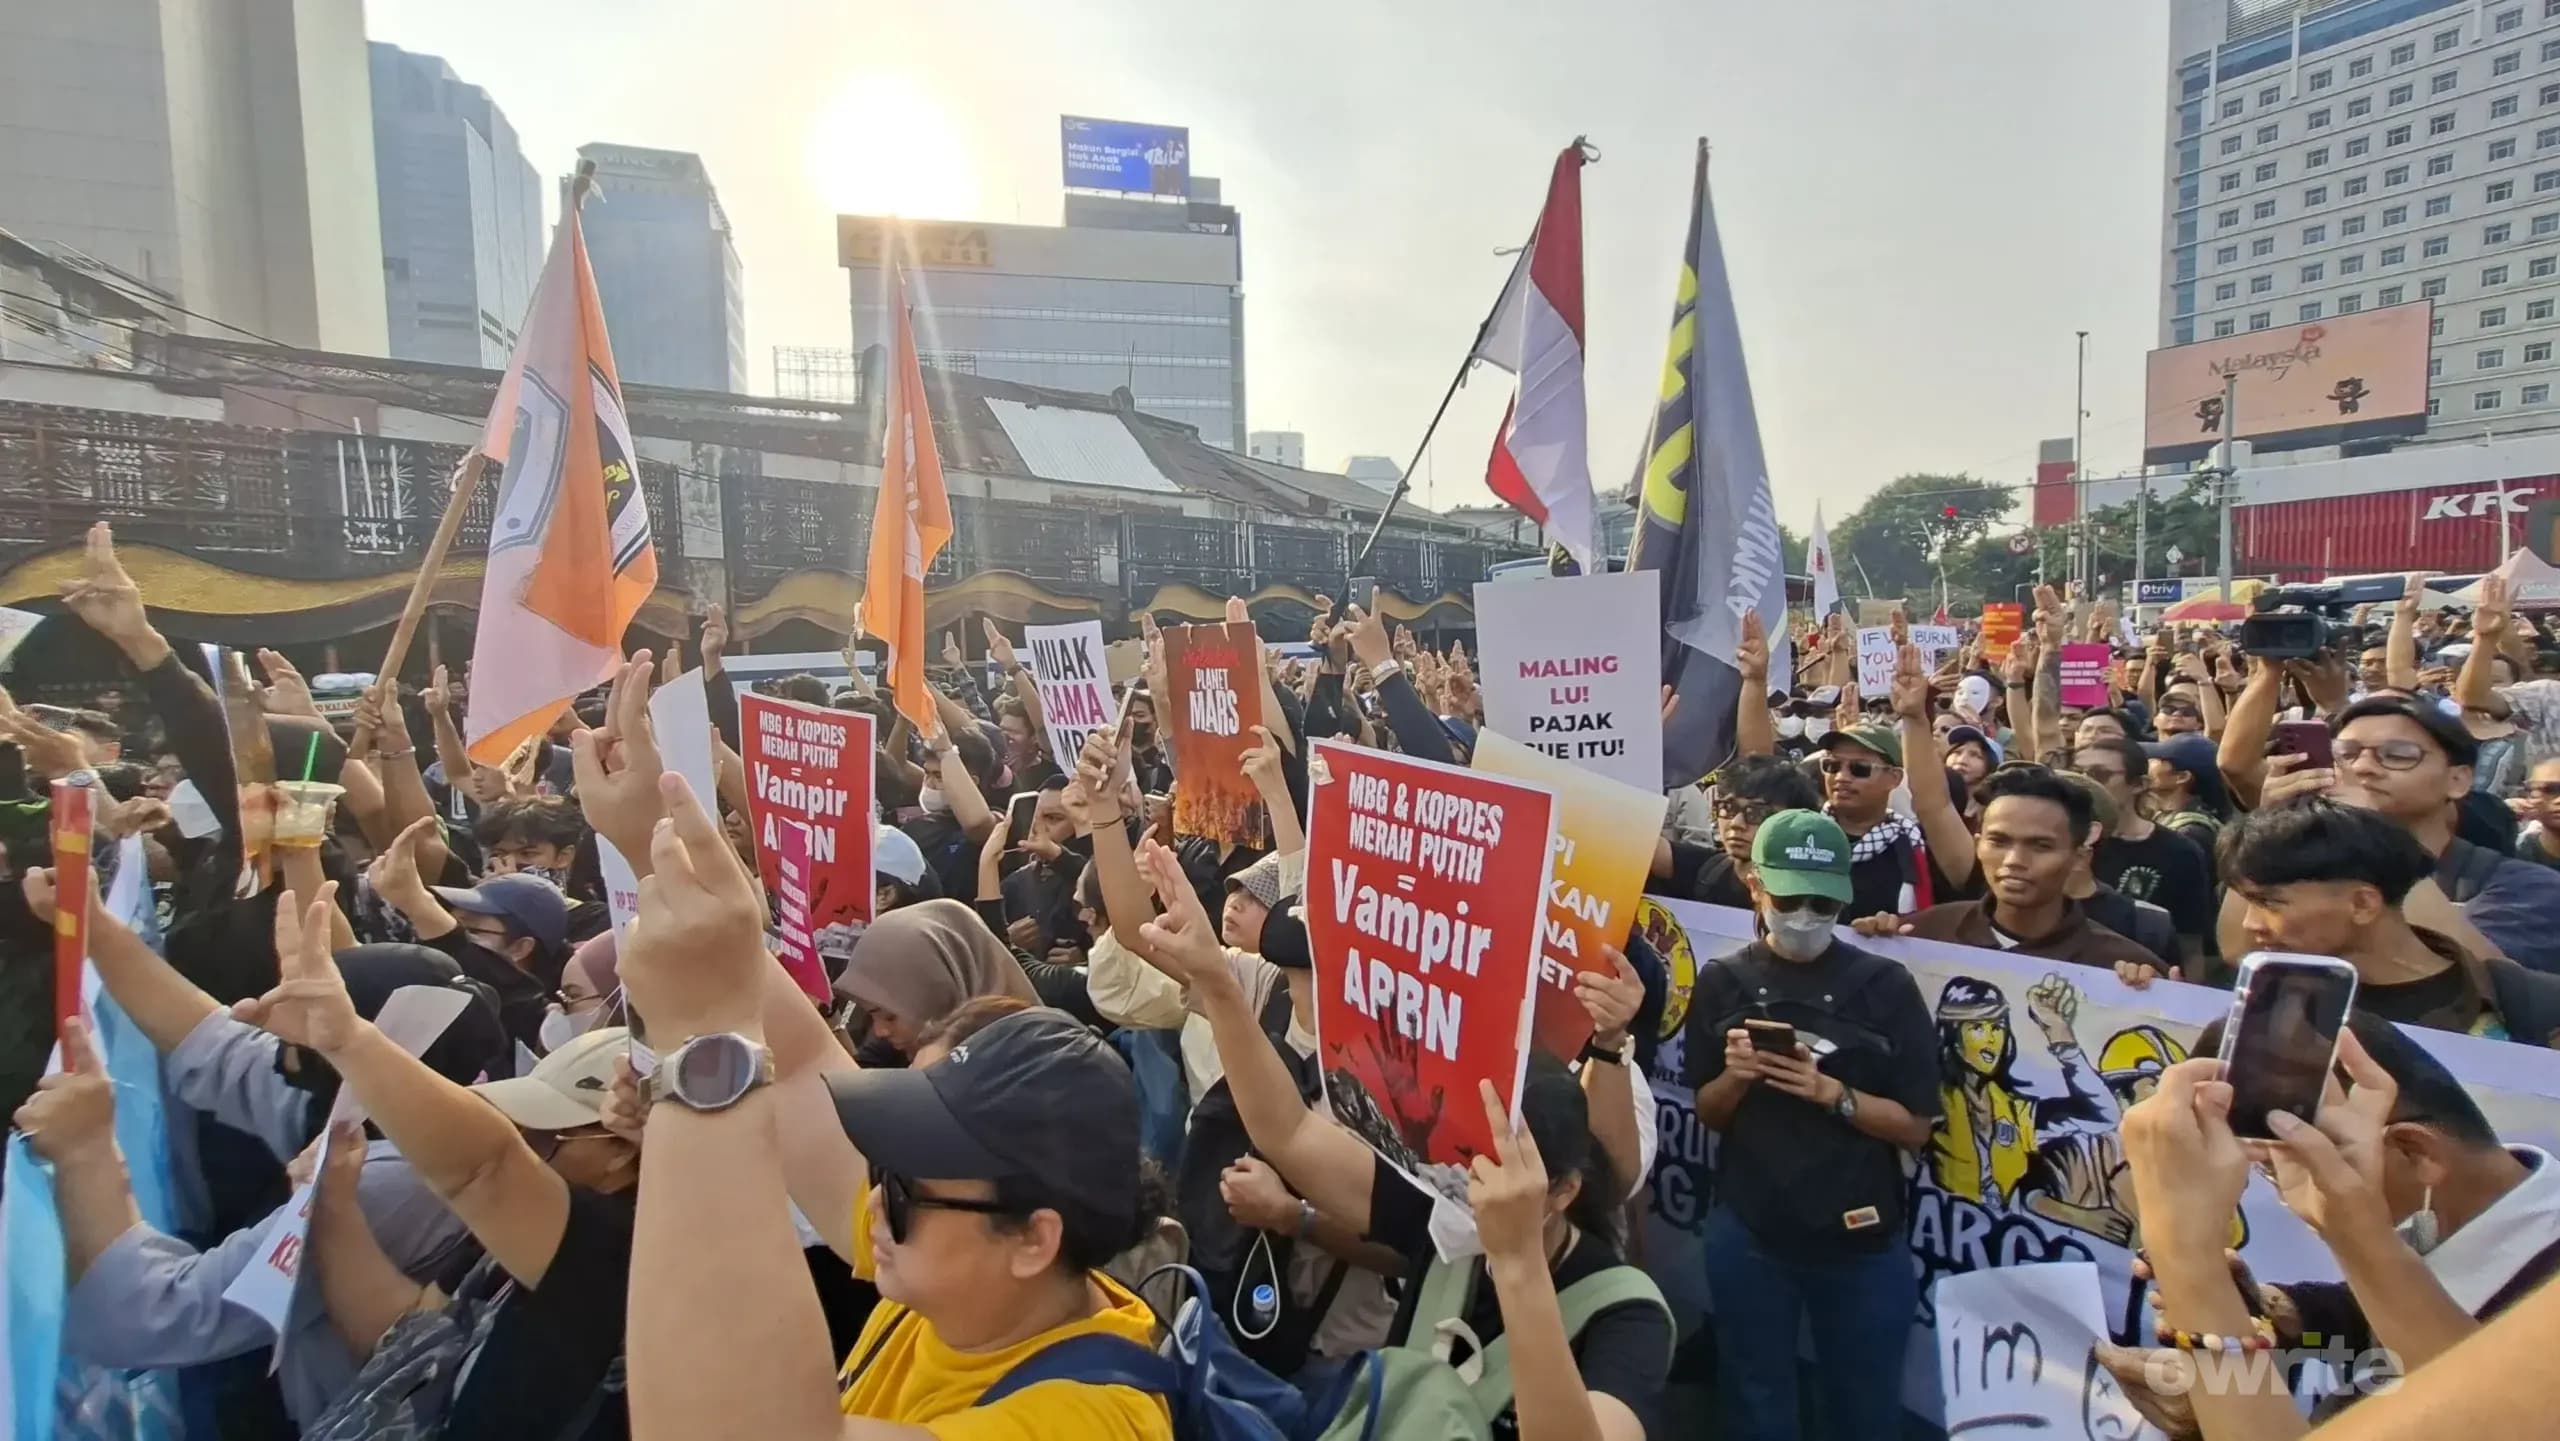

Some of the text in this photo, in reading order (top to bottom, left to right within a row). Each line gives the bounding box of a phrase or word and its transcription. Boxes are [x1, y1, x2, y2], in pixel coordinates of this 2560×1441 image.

[1068, 160, 1122, 172] Indonesia
[2208, 341, 2321, 381] Malaysia
[2422, 488, 2536, 520] KFC
[2151, 584, 2175, 594] triv
[1862, 632, 1879, 646] IF
[1915, 630, 1951, 644] BURN
[1032, 636, 1096, 681] MUAK
[1519, 655, 1618, 678] MALING
[1861, 652, 1894, 664] YOU
[1195, 668, 1229, 690] PLANET
[1550, 686, 1589, 705] LU!
[1042, 683, 1108, 726] SAMA
[1189, 688, 1240, 737] MARS
[1530, 712, 1612, 732] PAJAK
[760, 710, 847, 749] MBG & KOPDES
[1057, 727, 1098, 768] MP
[1524, 739, 1624, 759] UE ITU!
[762, 734, 838, 770] MERAH PUTIH
[754, 761, 848, 820] Vampir
[1349, 772, 1503, 849] MBG & KOPDES
[764, 812, 835, 863] AN
[1350, 813, 1484, 884] MERAH PUTIH
[1332, 858, 1492, 977] Vampir
[1344, 948, 1462, 1062] APBN
